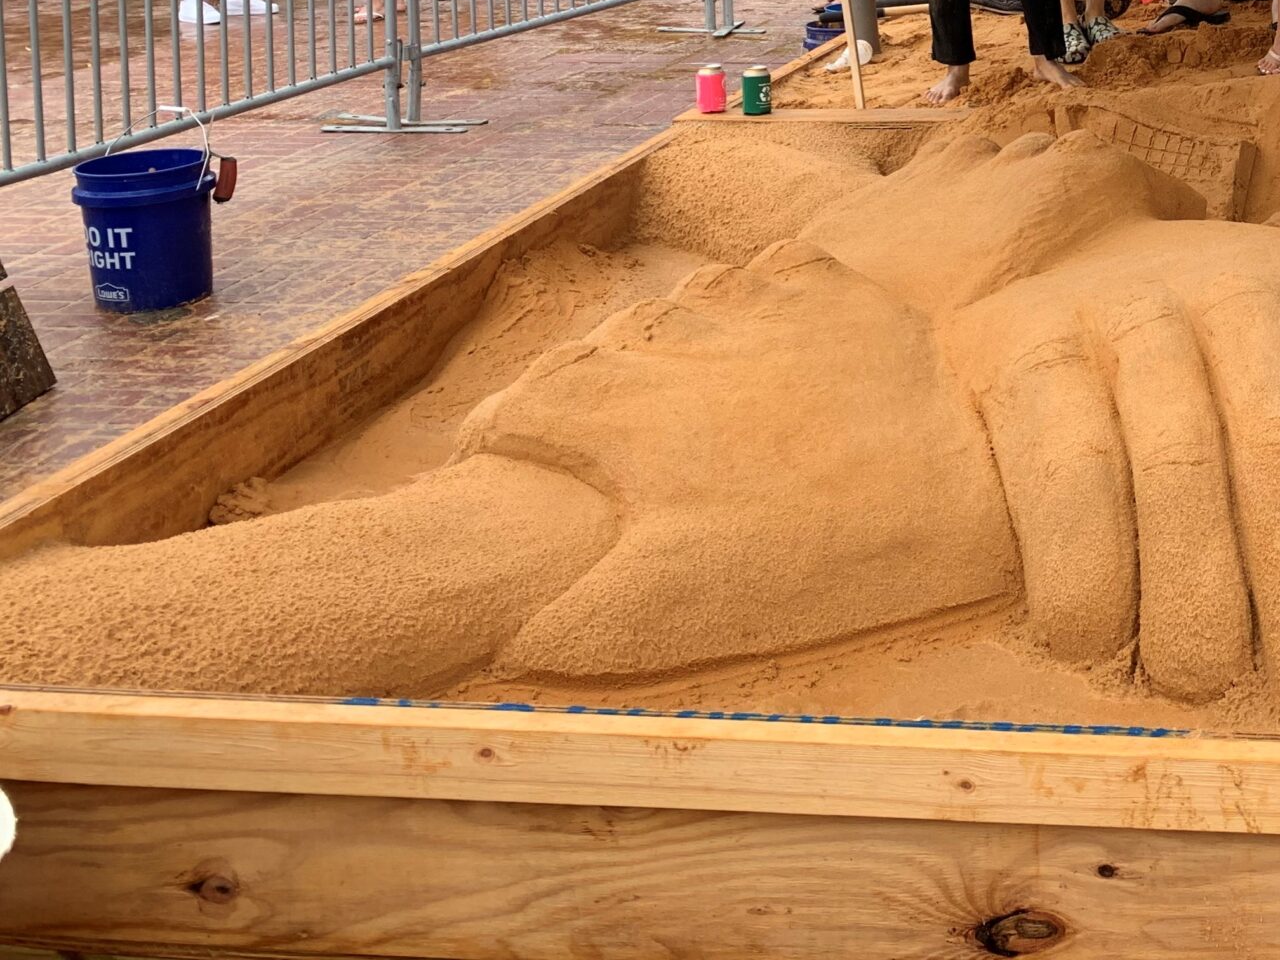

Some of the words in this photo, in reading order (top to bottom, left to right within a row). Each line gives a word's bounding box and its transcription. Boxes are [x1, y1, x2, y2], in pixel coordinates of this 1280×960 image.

[107, 228, 132, 248] IT
[88, 251, 136, 270] IGHT
[98, 291, 125, 299] LOWE'S
